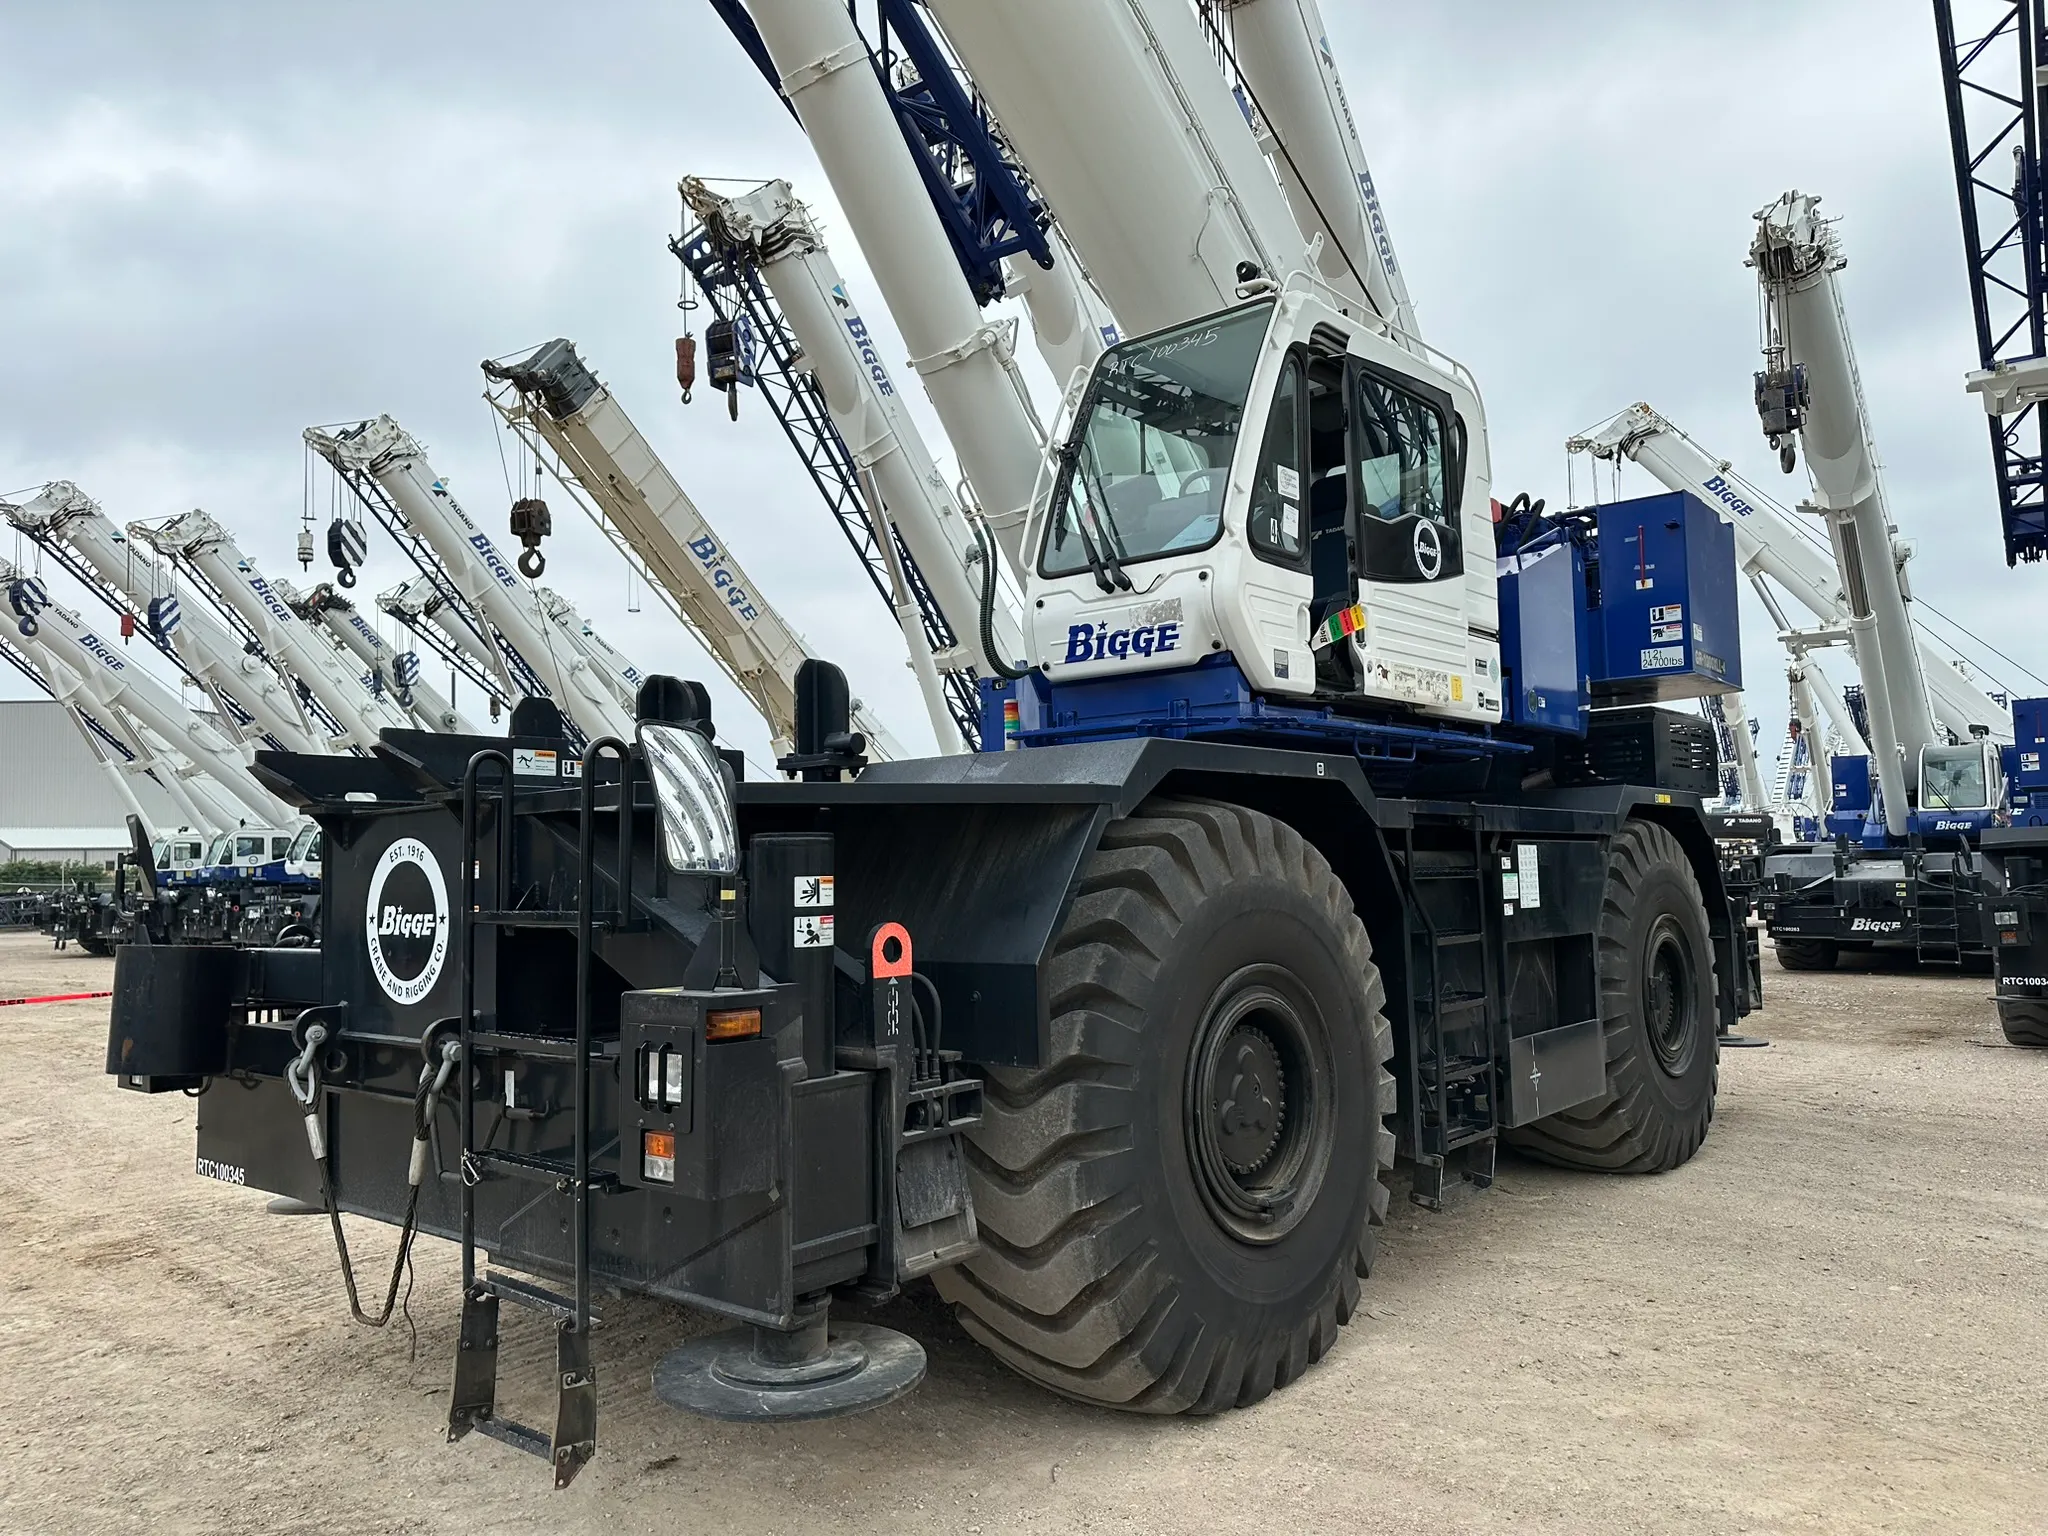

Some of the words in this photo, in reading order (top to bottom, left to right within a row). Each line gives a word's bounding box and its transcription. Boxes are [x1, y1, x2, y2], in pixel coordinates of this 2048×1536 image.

[1333, 75, 1356, 140] TADANO
[1107, 353, 1144, 378] RTC
[1148, 326, 1222, 362] 100345
[448, 499, 474, 530] TADANO
[54, 607, 79, 629] TADANO
[1642, 656, 1684, 669] 24700lbs
[389, 845, 405, 863] EST.
[407, 844, 425, 862] 1916
[370, 937, 387, 981] CRANE
[387, 979, 404, 997] AND
[405, 966, 436, 999] RIGGING
[434, 939, 445, 963] CO.
[2002, 976, 2048, 986] RTC1003
[197, 1157, 245, 1186] RTC100345
